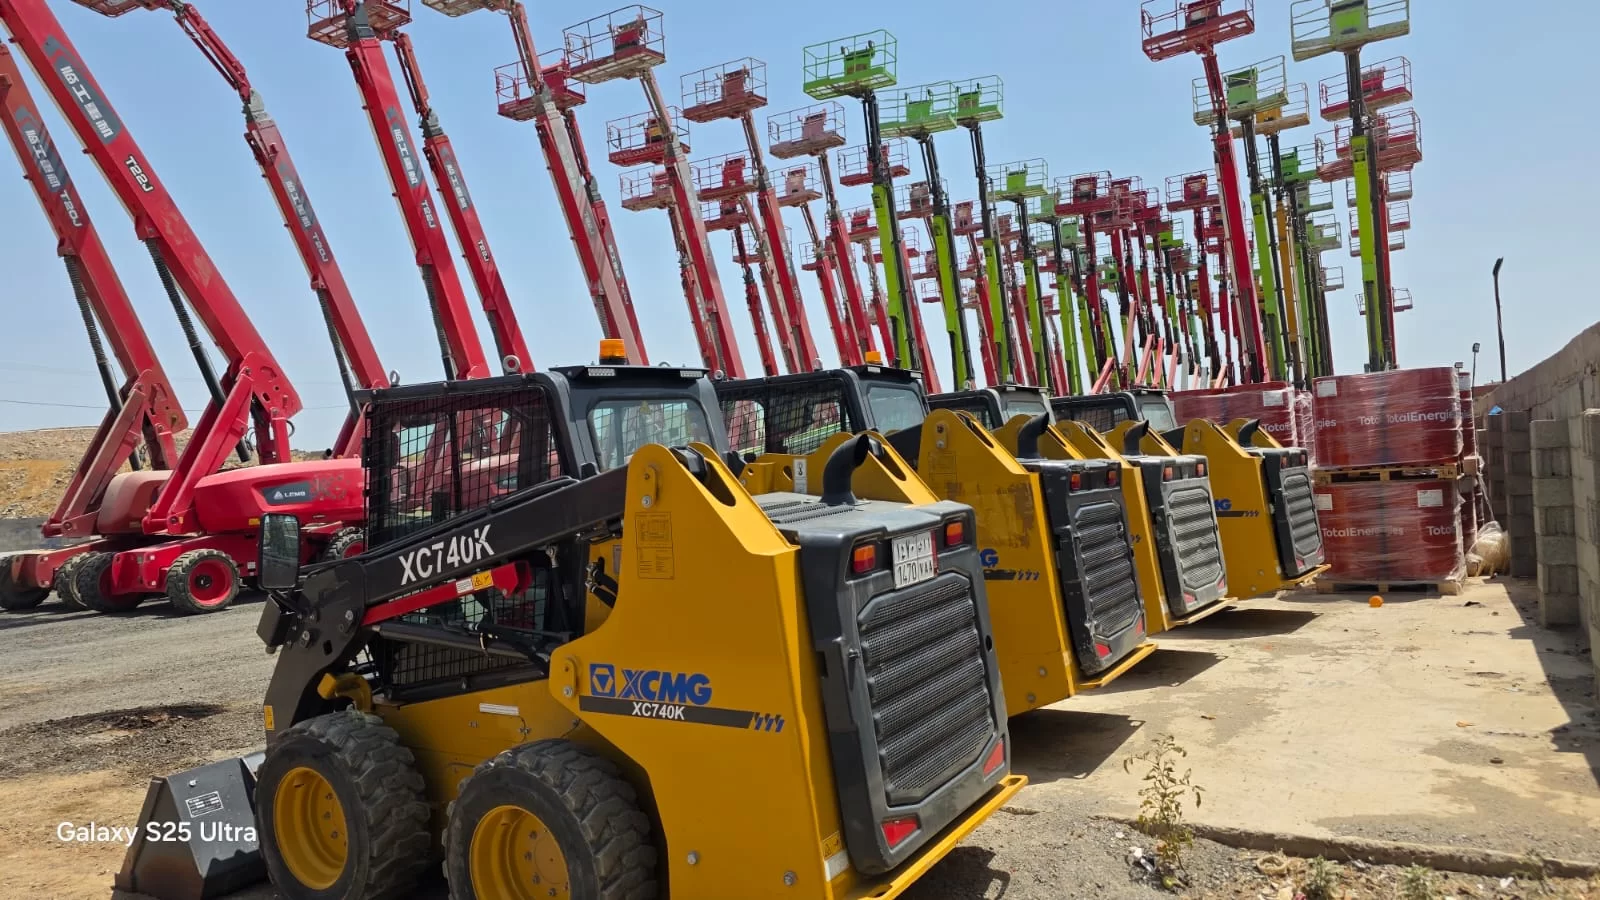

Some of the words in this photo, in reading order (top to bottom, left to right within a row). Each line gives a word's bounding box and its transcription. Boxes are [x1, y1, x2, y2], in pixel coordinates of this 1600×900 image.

[125, 155, 154, 193] T22J
[59, 189, 83, 228] T20J
[398, 523, 495, 586] XC740K
[898, 562, 917, 585] 1470
[618, 668, 713, 706] XCMG
[631, 701, 686, 720] XC740K
